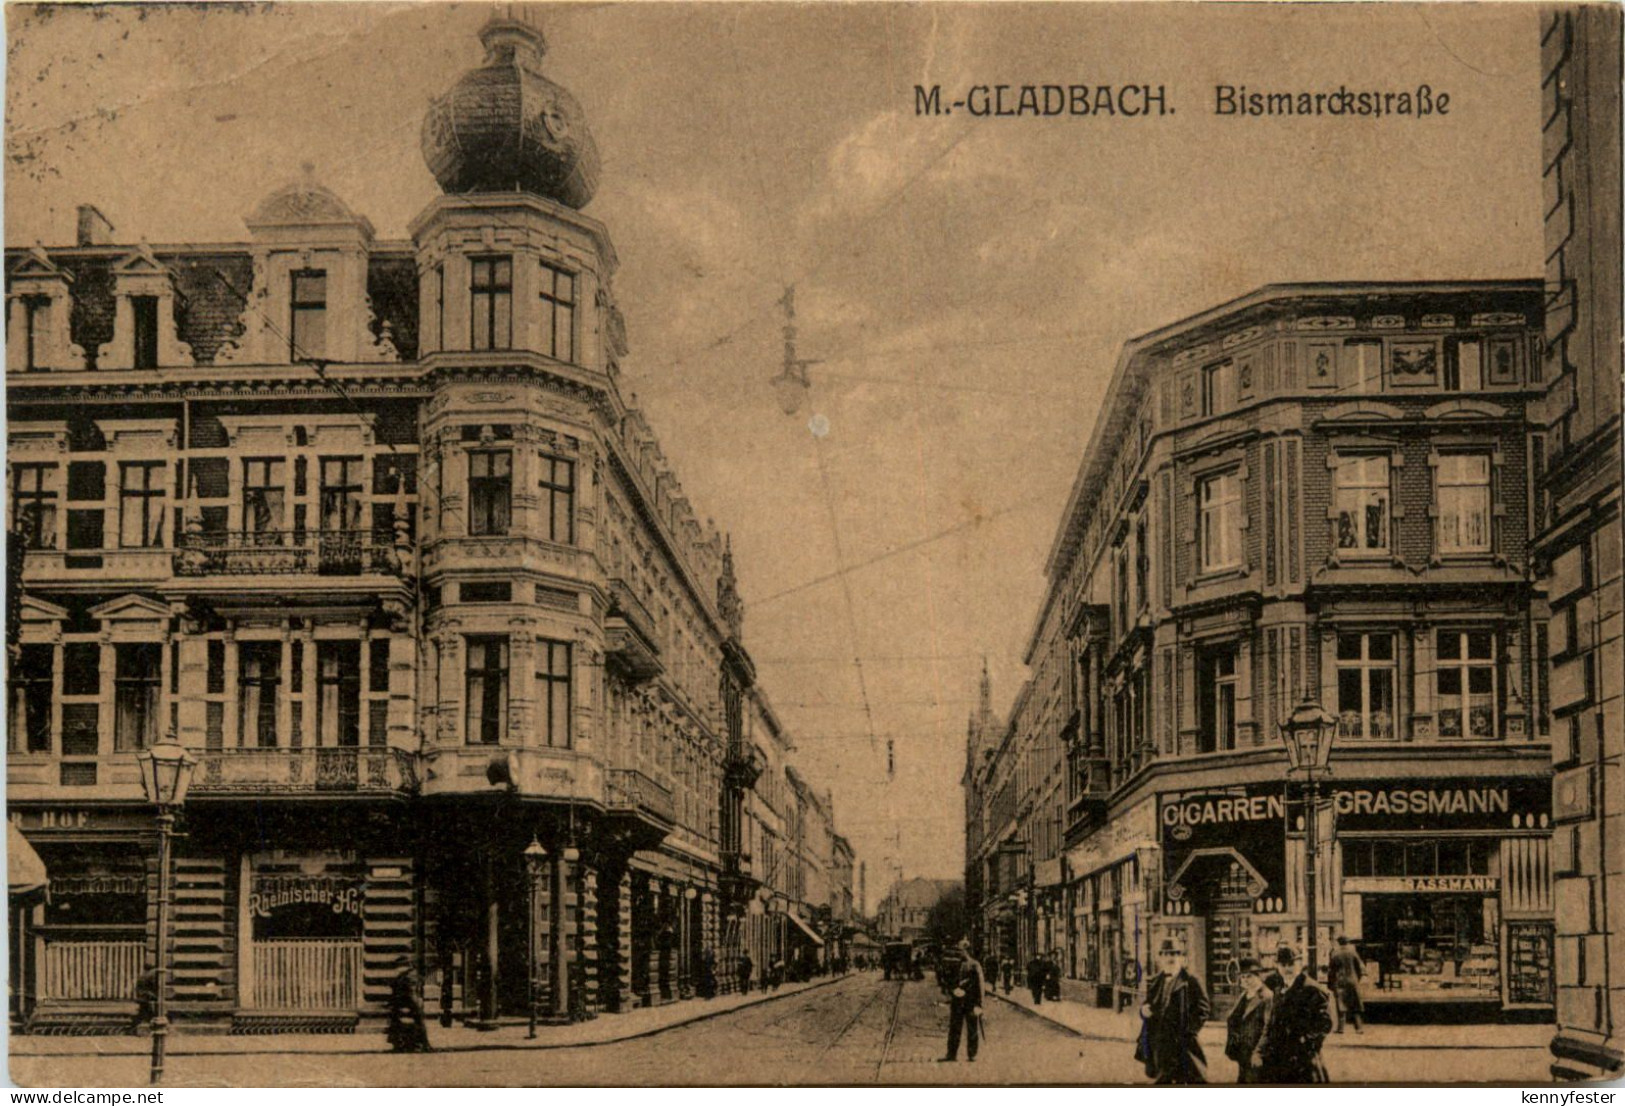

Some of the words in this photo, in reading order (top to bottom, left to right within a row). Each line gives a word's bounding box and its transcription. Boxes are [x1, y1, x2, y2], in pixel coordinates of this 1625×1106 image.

[1163, 794, 1285, 826] CIGARREN
[1335, 788, 1509, 815] GRASSMANN
[250, 884, 334, 918] Rheinischer
